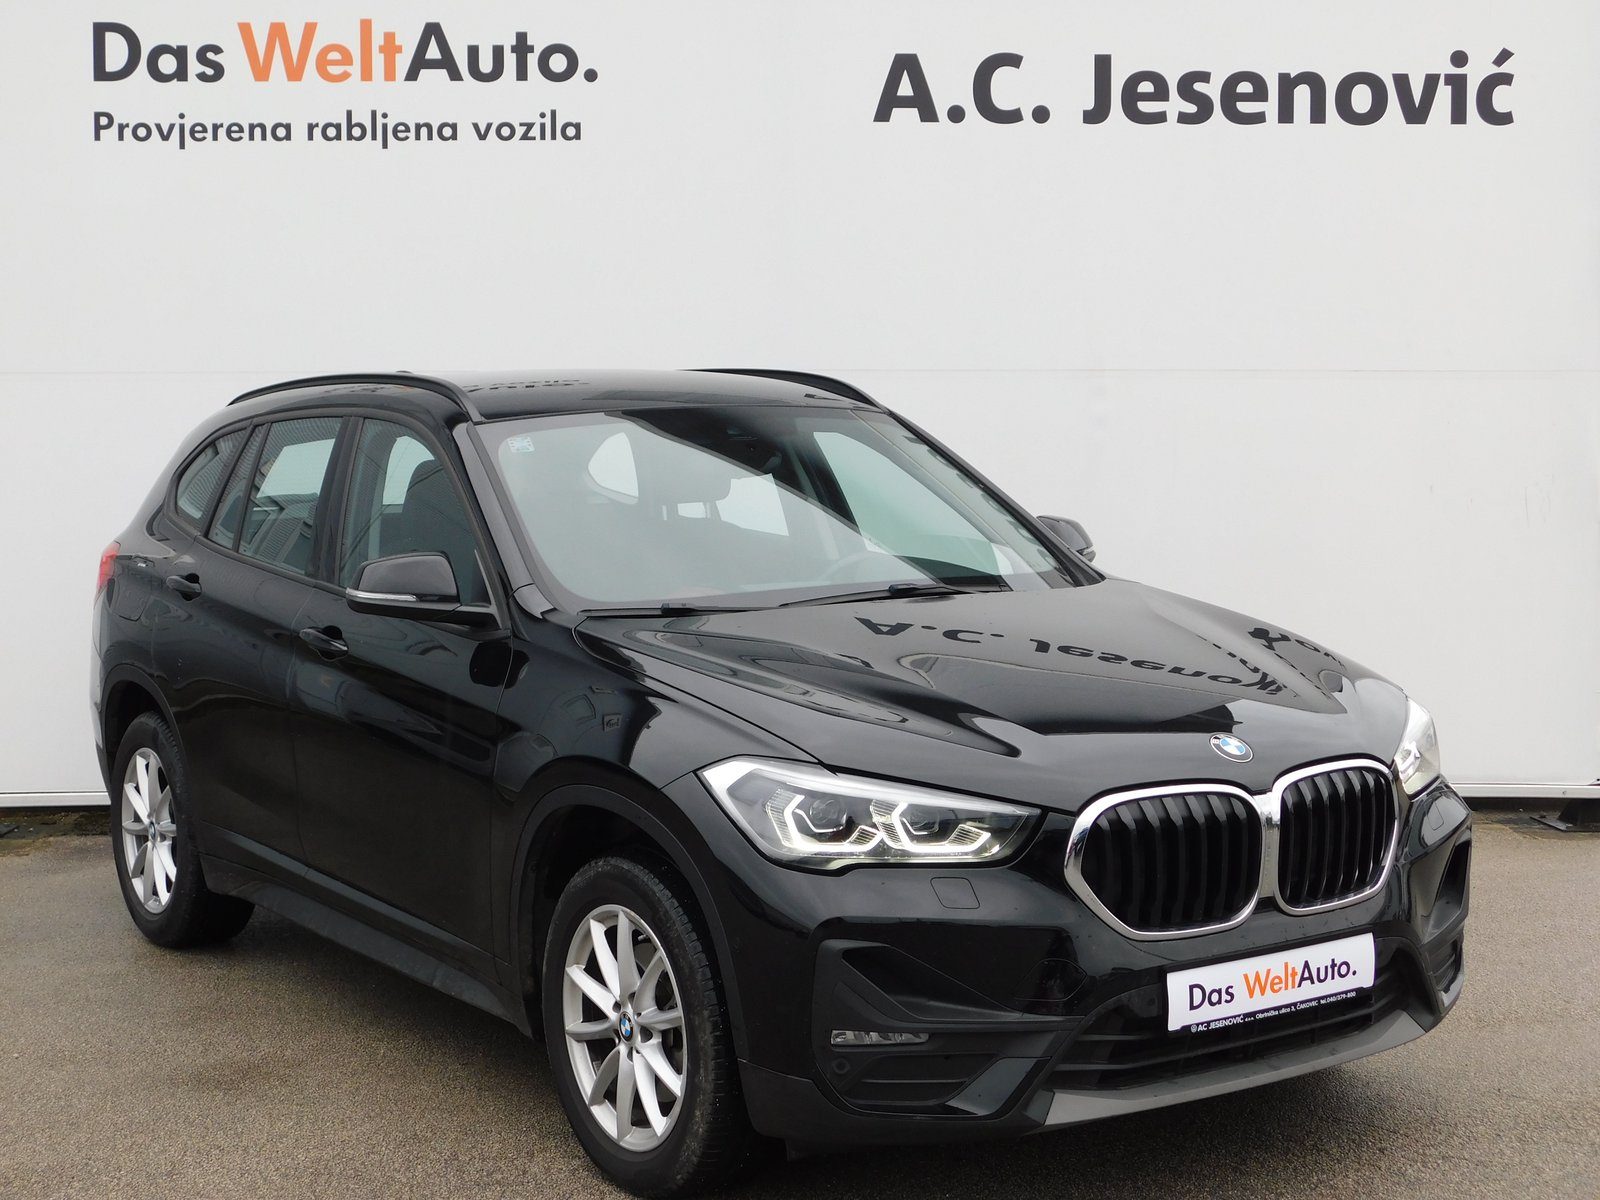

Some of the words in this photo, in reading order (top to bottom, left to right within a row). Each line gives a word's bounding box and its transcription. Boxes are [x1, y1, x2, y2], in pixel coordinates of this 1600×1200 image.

[93, 22, 225, 83] Das
[238, 19, 598, 83] WeltAuto.
[872, 53, 1051, 125] A.C.
[1083, 48, 1515, 126] Jesenović
[93, 111, 292, 149] Provjerena
[307, 110, 458, 149] rabljena
[472, 110, 582, 142] vozila
[1188, 982, 1235, 1011] Das
[1243, 958, 1357, 999] WeltAuto.
